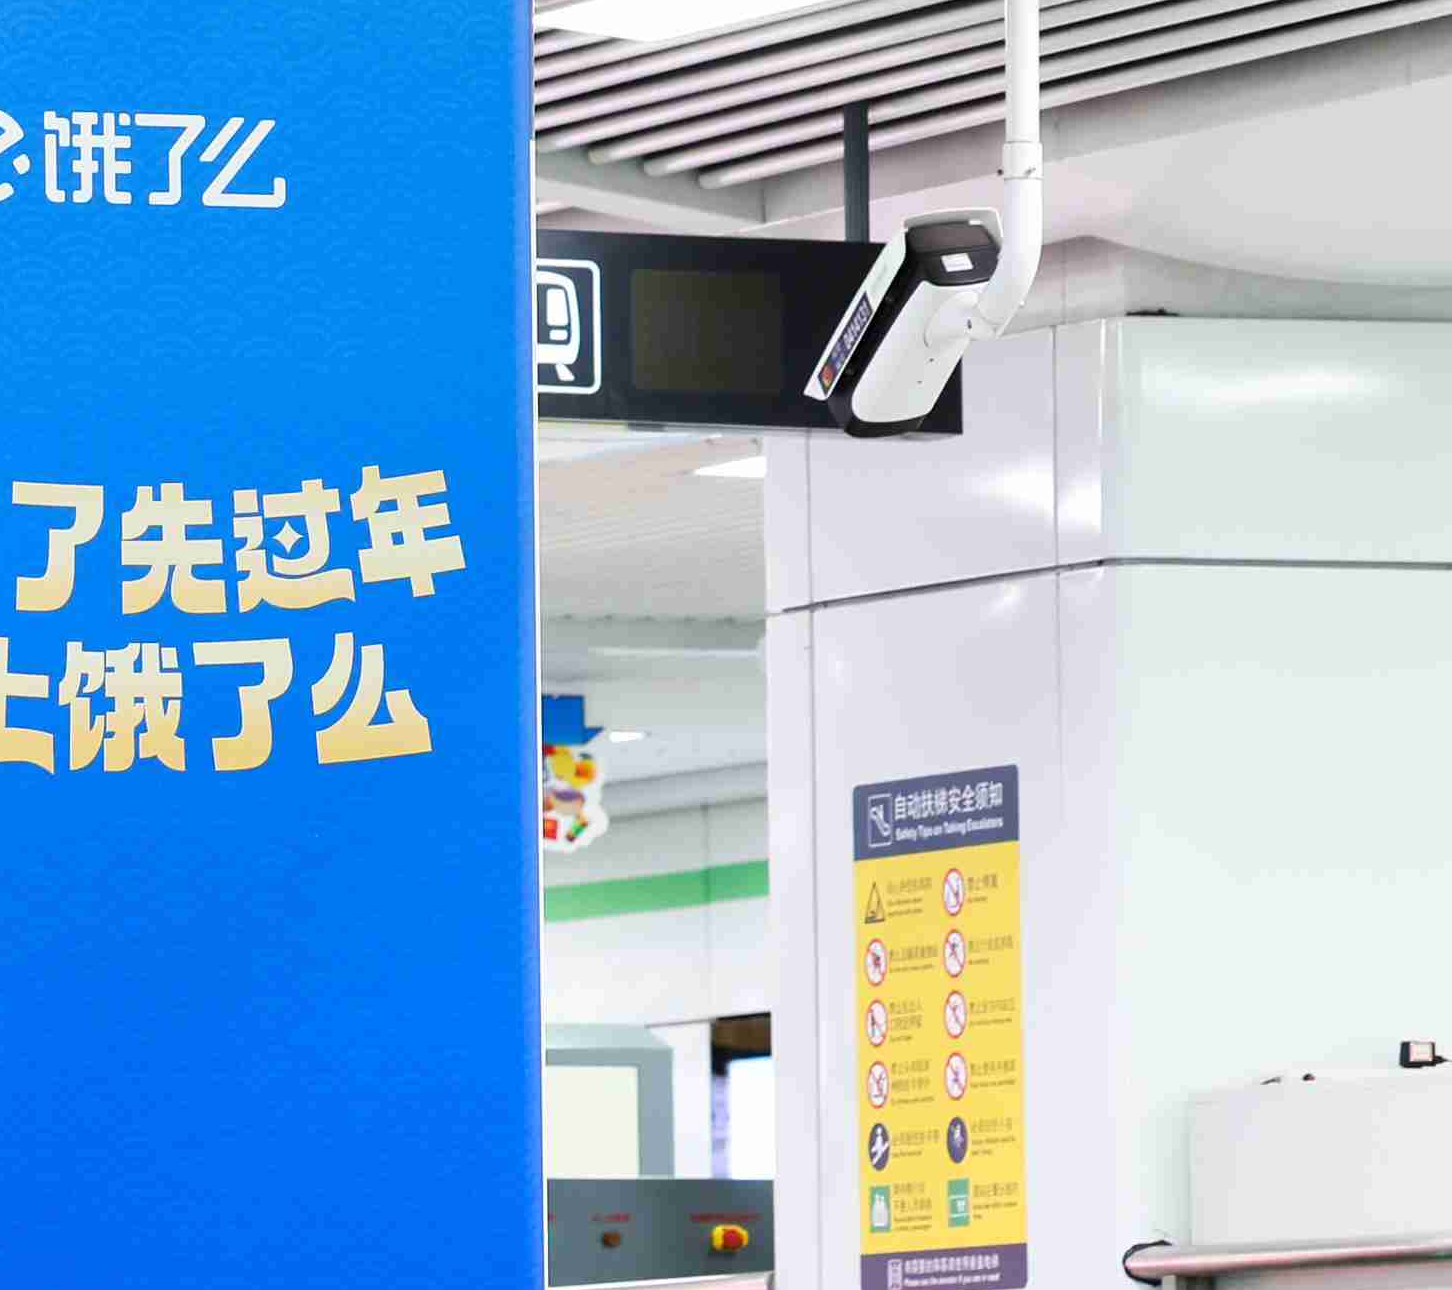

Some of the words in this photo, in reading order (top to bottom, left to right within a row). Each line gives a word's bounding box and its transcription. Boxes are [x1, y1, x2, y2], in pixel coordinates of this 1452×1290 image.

[894, 781, 1004, 821] 自动扶梯安全须知
